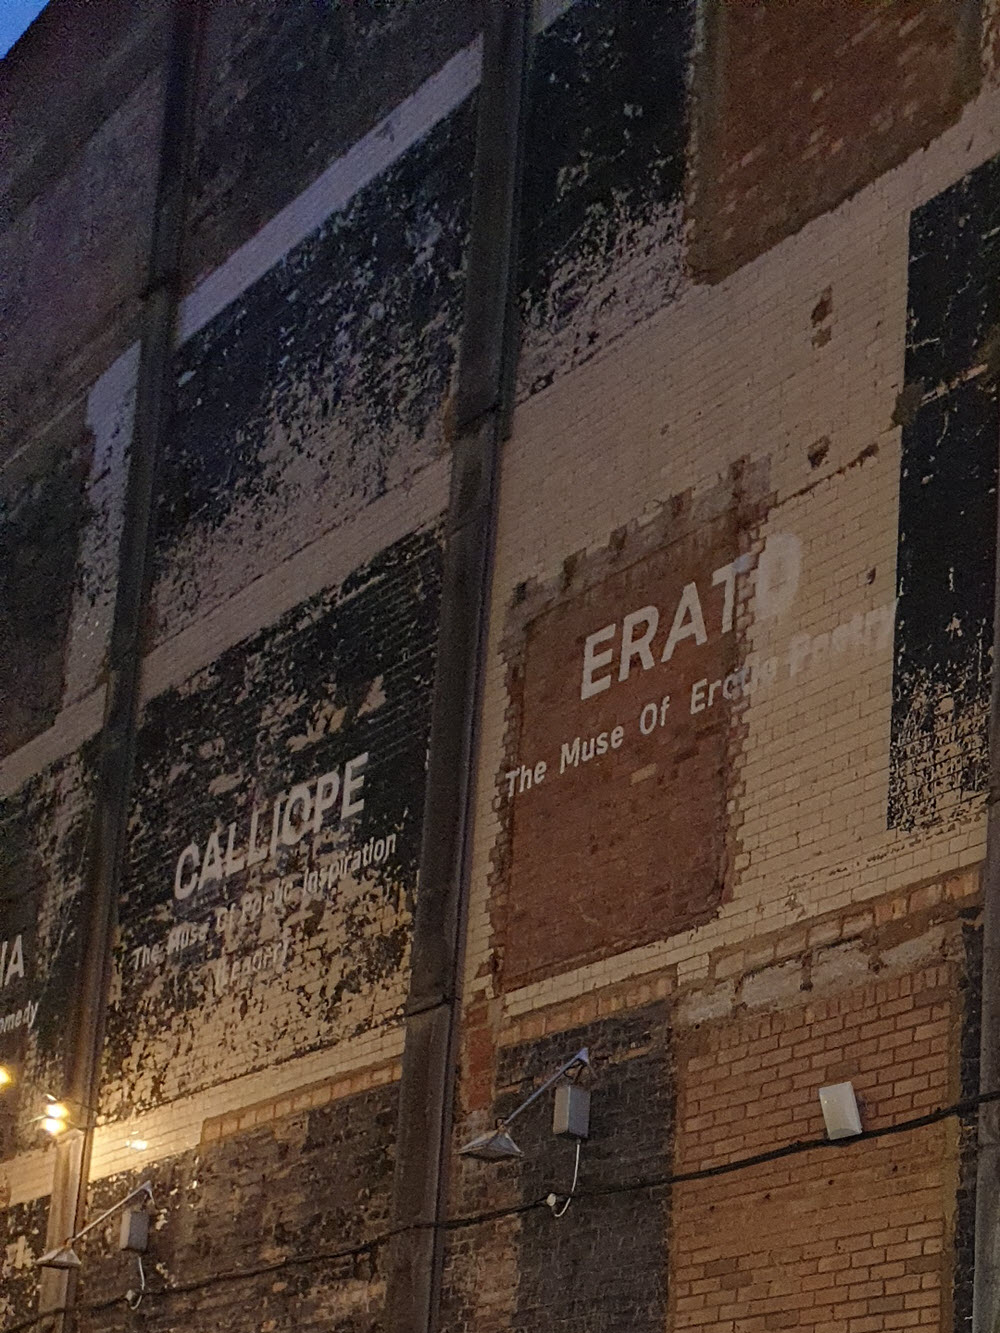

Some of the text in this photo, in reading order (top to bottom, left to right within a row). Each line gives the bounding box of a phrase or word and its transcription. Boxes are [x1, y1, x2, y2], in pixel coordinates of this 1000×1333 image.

[580, 532, 799, 701] ERATO
[505, 758, 547, 799] The
[559, 723, 625, 775] Muse
[638, 695, 671, 737] Of
[174, 751, 370, 900] CALLIOPE
[302, 832, 397, 895] Inspiration
